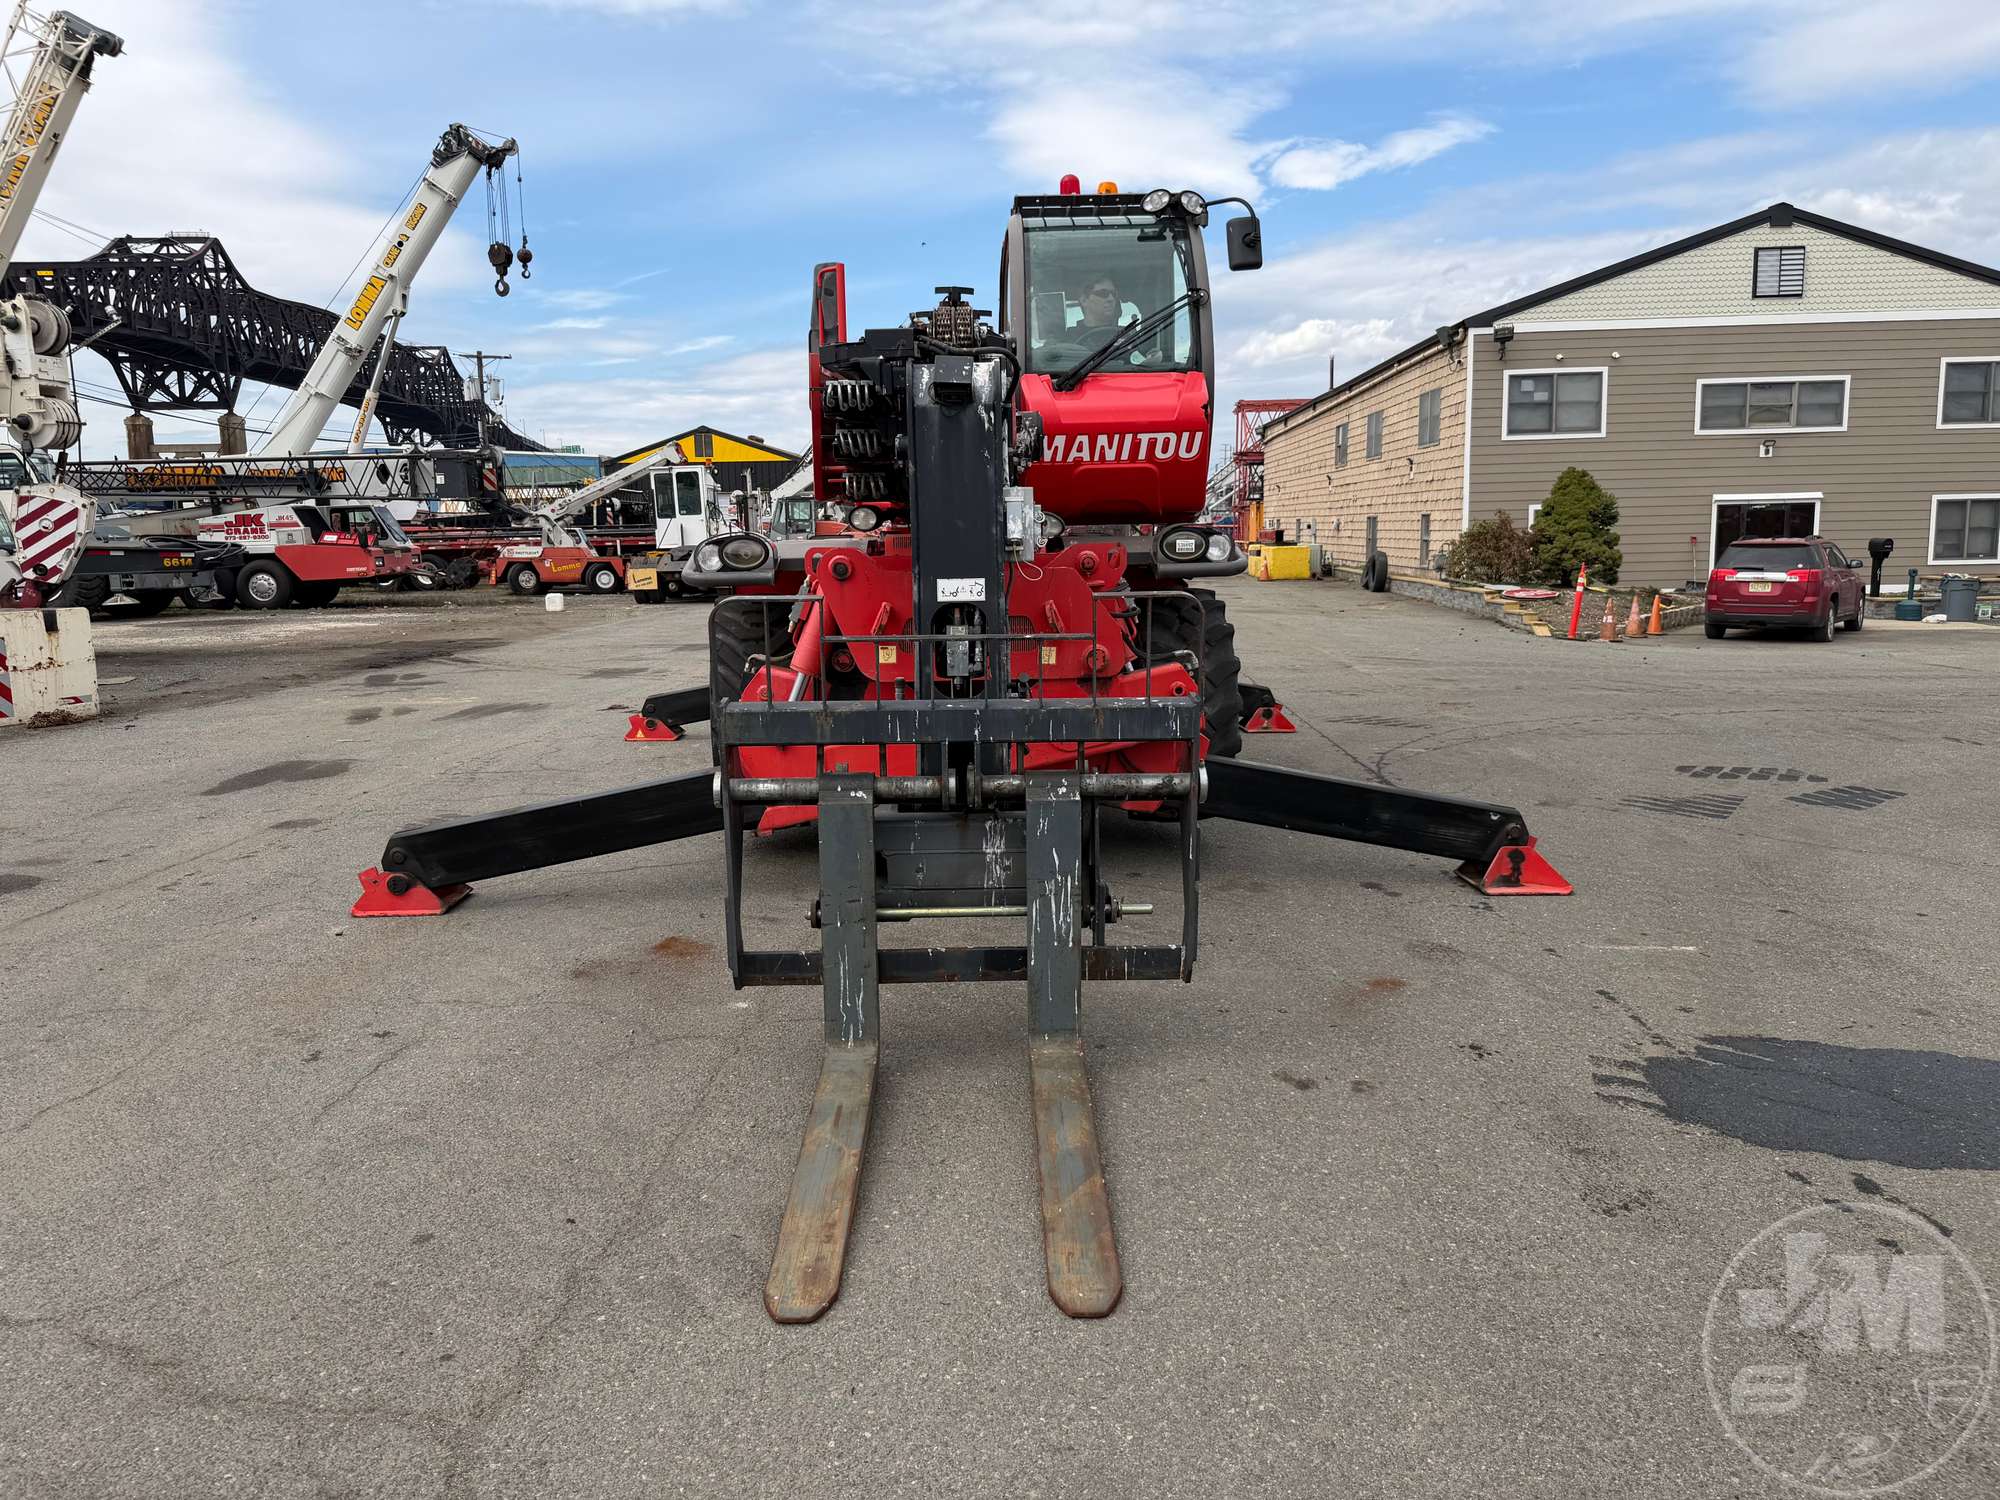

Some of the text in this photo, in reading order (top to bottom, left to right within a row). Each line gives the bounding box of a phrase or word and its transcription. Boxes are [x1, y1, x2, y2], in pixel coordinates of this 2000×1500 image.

[344, 275, 388, 331] LOMMA
[383, 244, 402, 268] CRANE
[1042, 431, 1203, 463] MANITOU
[224, 513, 266, 527] JK
[225, 527, 266, 536] CRANE
